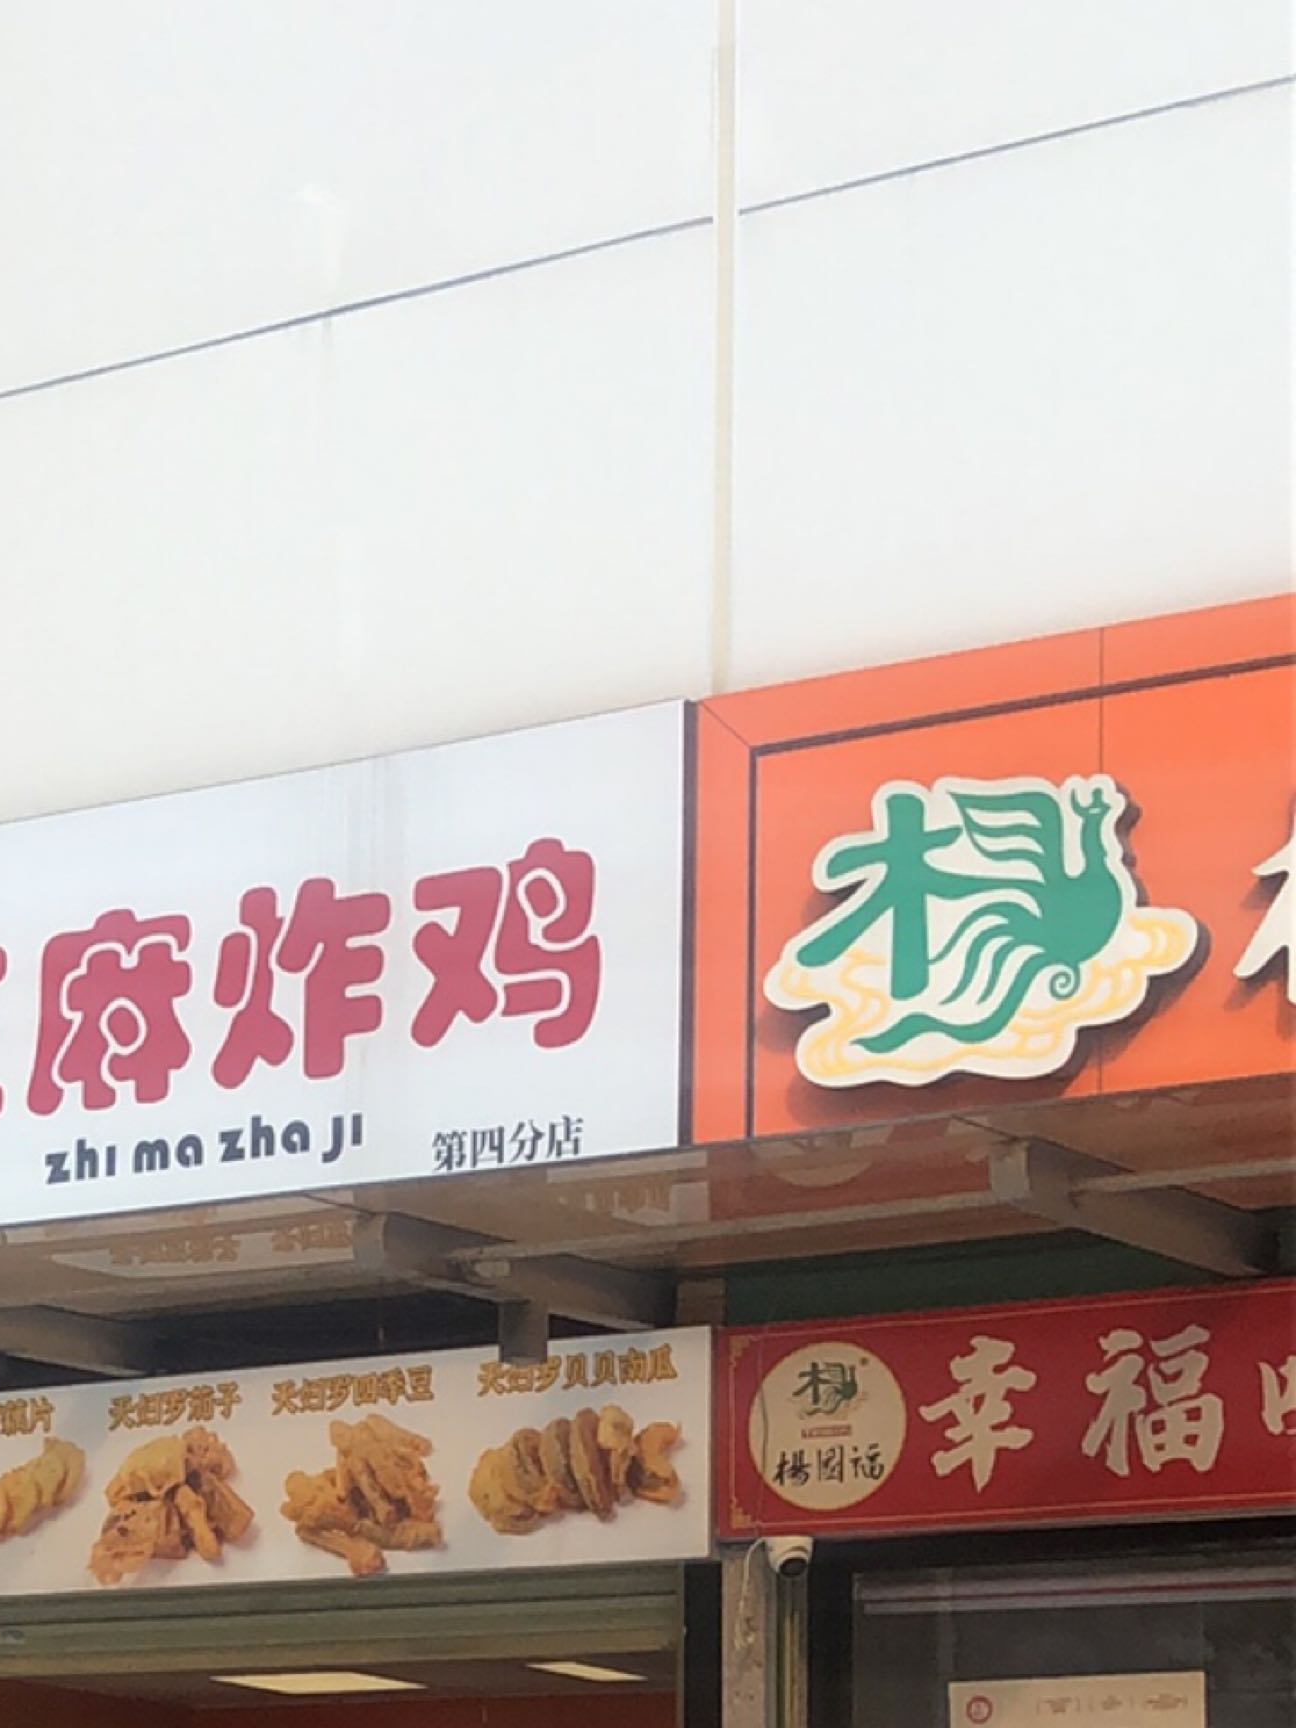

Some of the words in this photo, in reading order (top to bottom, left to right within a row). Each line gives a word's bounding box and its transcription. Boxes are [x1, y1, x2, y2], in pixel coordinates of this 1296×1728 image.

[133, 1133, 204, 1176] ma
[218, 1115, 311, 1164] zha
[431, 1114, 584, 1172] 第四分店
